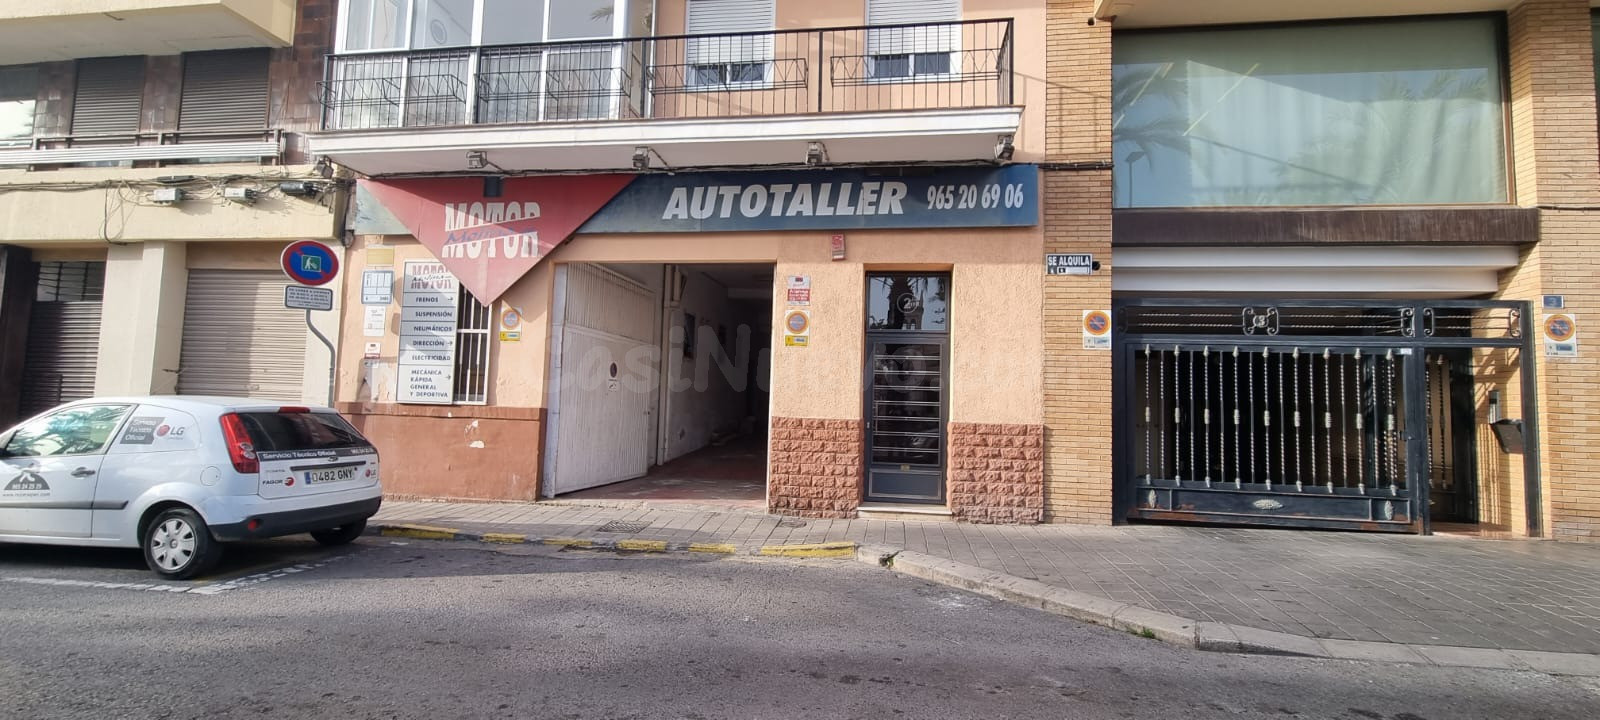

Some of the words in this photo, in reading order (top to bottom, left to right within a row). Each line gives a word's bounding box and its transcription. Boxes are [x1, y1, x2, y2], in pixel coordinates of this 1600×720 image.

[662, 181, 907, 220] AUTOTALLER
[927, 185, 954, 210] 965
[958, 185, 978, 209] 20
[981, 184, 1000, 209] 69
[1005, 183, 1024, 209] 06
[441, 201, 541, 259] MOTOR
[1047, 256, 1057, 266] SE
[1058, 256, 1090, 266] ALQUILA
[411, 264, 452, 289] MOTOR
[415, 310, 453, 318] SUSPENSIÓN
[412, 339, 445, 347] DIRECCIÓN
[170, 426, 185, 436] LG
[311, 470, 336, 482] 0482
[337, 468, 354, 480] GNY
